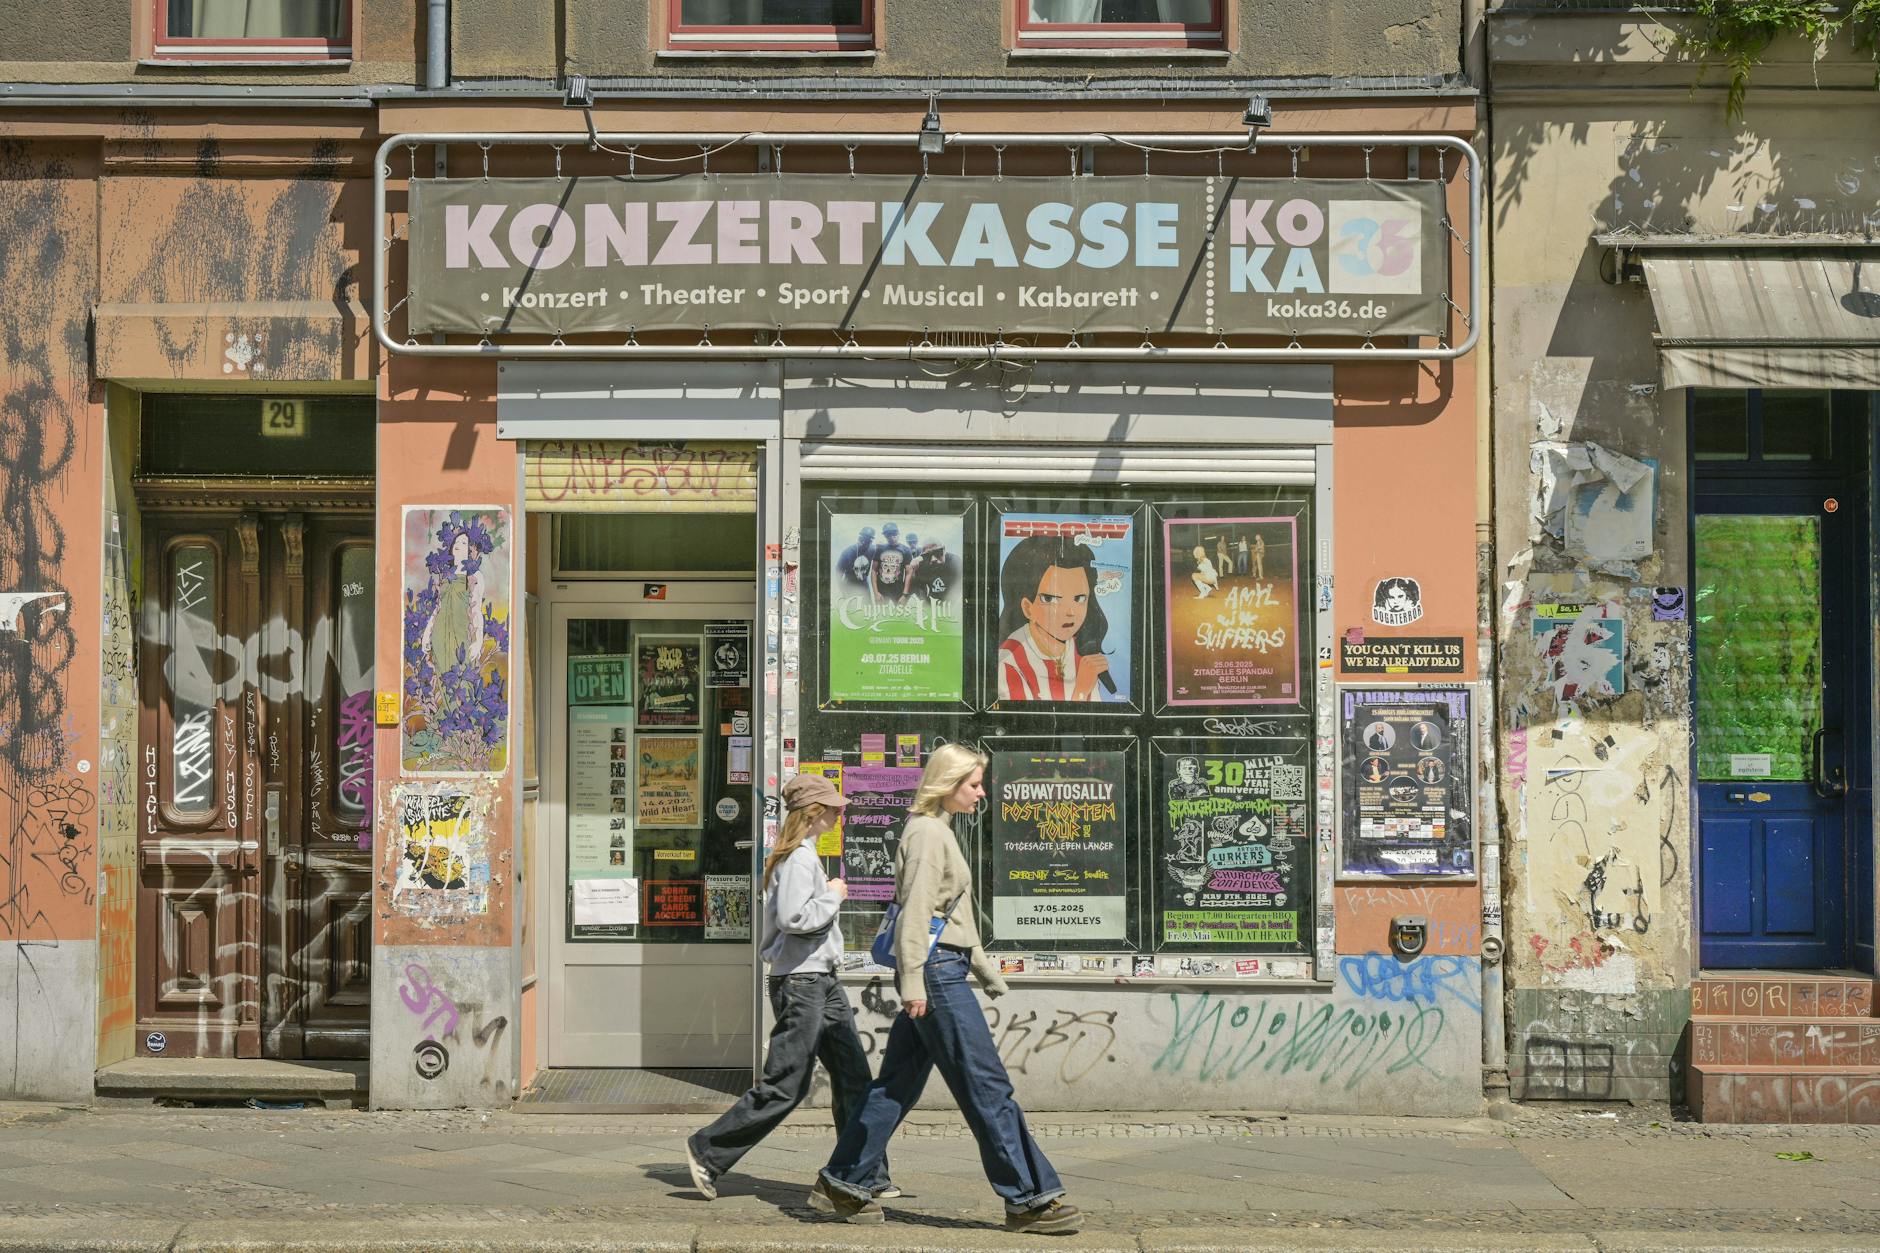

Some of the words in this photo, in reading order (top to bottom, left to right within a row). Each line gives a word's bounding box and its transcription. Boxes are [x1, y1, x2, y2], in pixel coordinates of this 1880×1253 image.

[1229, 199, 1325, 246] KO
[445, 199, 1180, 270] KONZERTKASSE
[1337, 217, 1415, 278] 36
[1229, 247, 1326, 293] KA
[502, 286, 607, 309] Konzert
[640, 283, 746, 306] Theater
[778, 282, 850, 310] Sport
[882, 284, 984, 308] Musical
[1018, 285, 1139, 308] Kabarett
[1266, 298, 1388, 320] koka36.de
[268, 401, 296, 429] 29
[838, 595, 912, 632] Cypress
[1345, 645, 1371, 655] YOU
[1413, 645, 1442, 655] KILL
[1444, 645, 1460, 655] US
[900, 653, 931, 664] BERLIN
[1382, 657, 1430, 667] ALREADY
[1431, 657, 1460, 667] DEAD
[576, 664, 593, 673] YES
[595, 663, 621, 673] WE'RE
[879, 664, 913, 675] ZITADELLE
[1193, 668, 1235, 676] ZITADELLE
[1236, 667, 1274, 676] SPANDAU
[1219, 675, 1249, 683] BERLIN
[575, 674, 624, 698] OPEN
[1204, 760, 1245, 786] 30
[1244, 756, 1284, 769] WILD
[1244, 779, 1271, 787] YEAR
[1214, 785, 1271, 795] anniversar
[851, 796, 913, 807] OFFENDE
[640, 808, 659, 817] Wild
[662, 807, 671, 815] At
[672, 803, 695, 813] Heart
[1001, 801, 1044, 822] POST
[1045, 801, 1116, 822] MORTEM
[1037, 820, 1081, 841] TOUR
[1004, 841, 1054, 852] TOTGESAGTE
[1056, 841, 1081, 852] LEBEN
[1083, 841, 1114, 852] LÄNGER
[1212, 851, 1264, 862] LURKERS
[735, 875, 750, 883] Drop
[1214, 871, 1260, 880] CHURCH
[1261, 872, 1280, 881] OF
[1208, 880, 1283, 890] CONFIDENCE
[661, 887, 688, 895] SORRY
[654, 895, 666, 903] NO
[668, 895, 697, 903] CREDIT
[661, 903, 689, 911] CARDS
[1033, 904, 1084, 912] 17.05.2025
[654, 911, 697, 919] ACCEPTED
[1016, 917, 1053, 925] BERLIN
[1055, 917, 1101, 925] HUXLEYS
[1167, 931, 1180, 940] Fr.
[1246, 931, 1261, 940] AT
[1263, 931, 1293, 940] HEART
